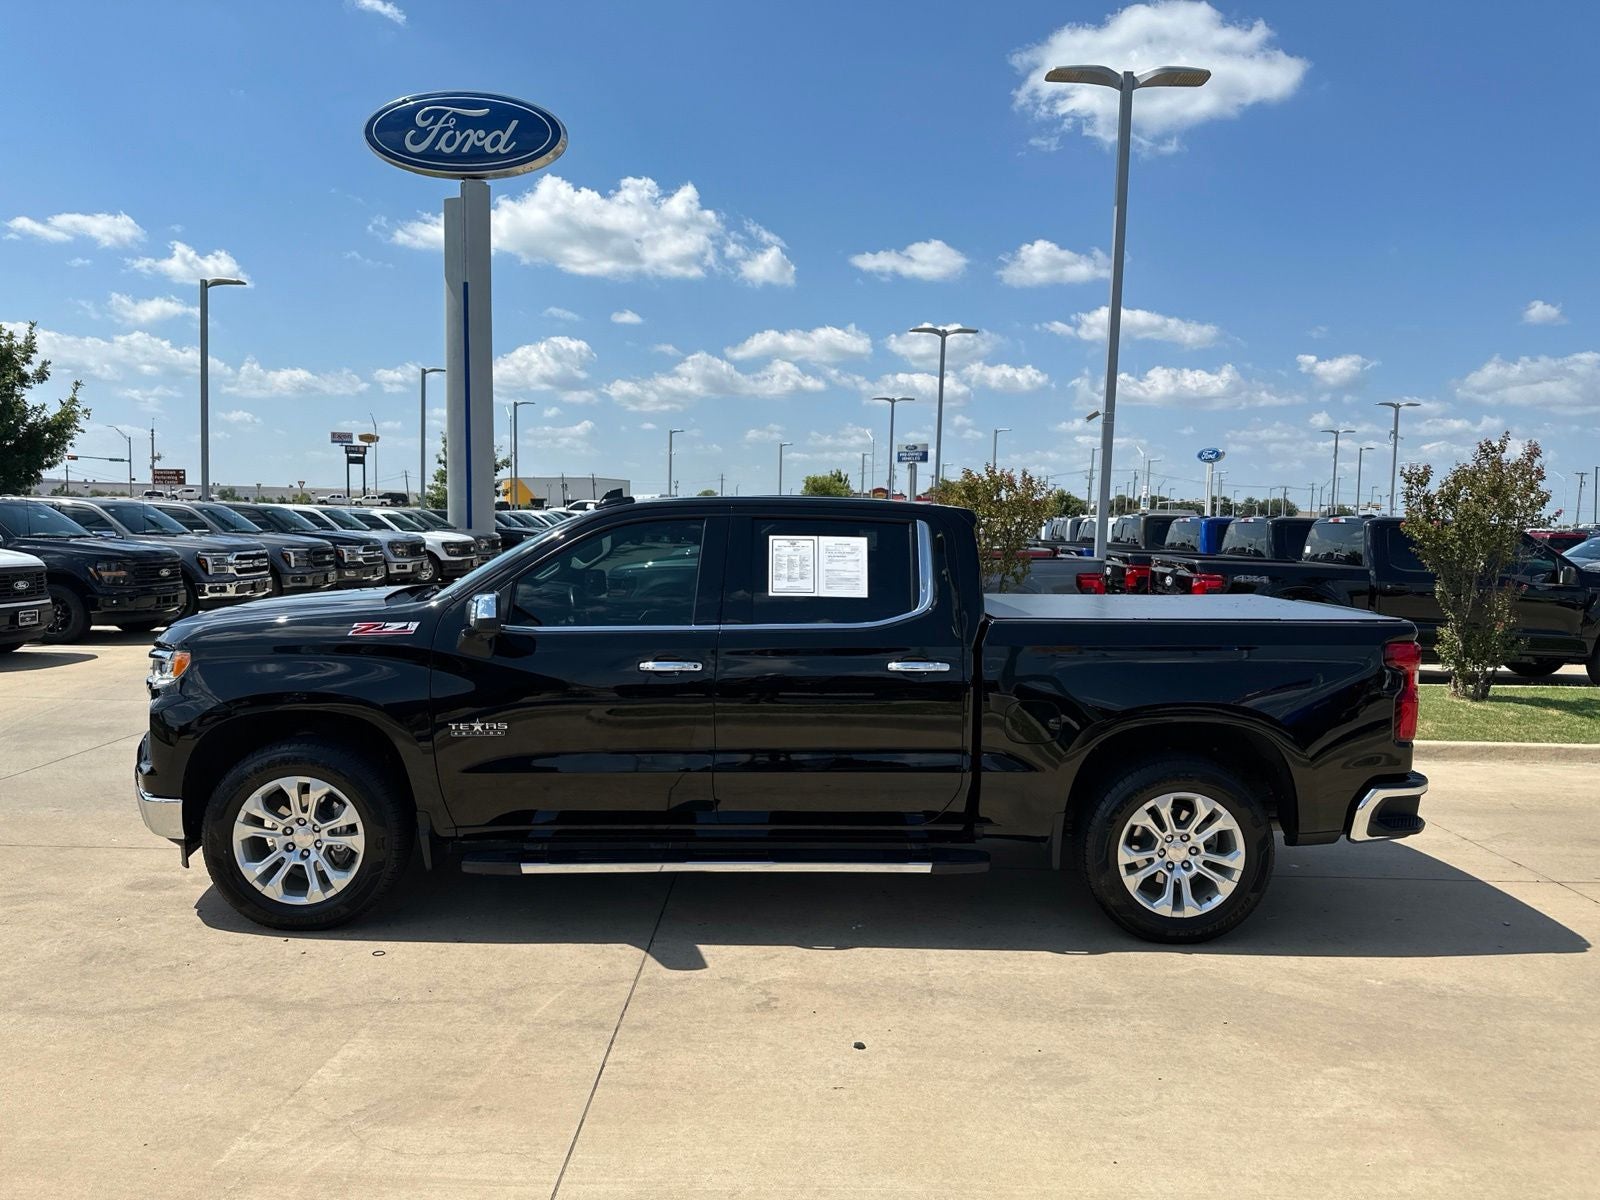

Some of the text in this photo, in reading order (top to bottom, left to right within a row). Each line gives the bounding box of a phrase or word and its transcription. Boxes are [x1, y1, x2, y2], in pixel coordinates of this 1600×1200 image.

[404, 105, 519, 154] Ford
[1201, 450, 1217, 460] Ford
[448, 717, 508, 732] TEXAS
